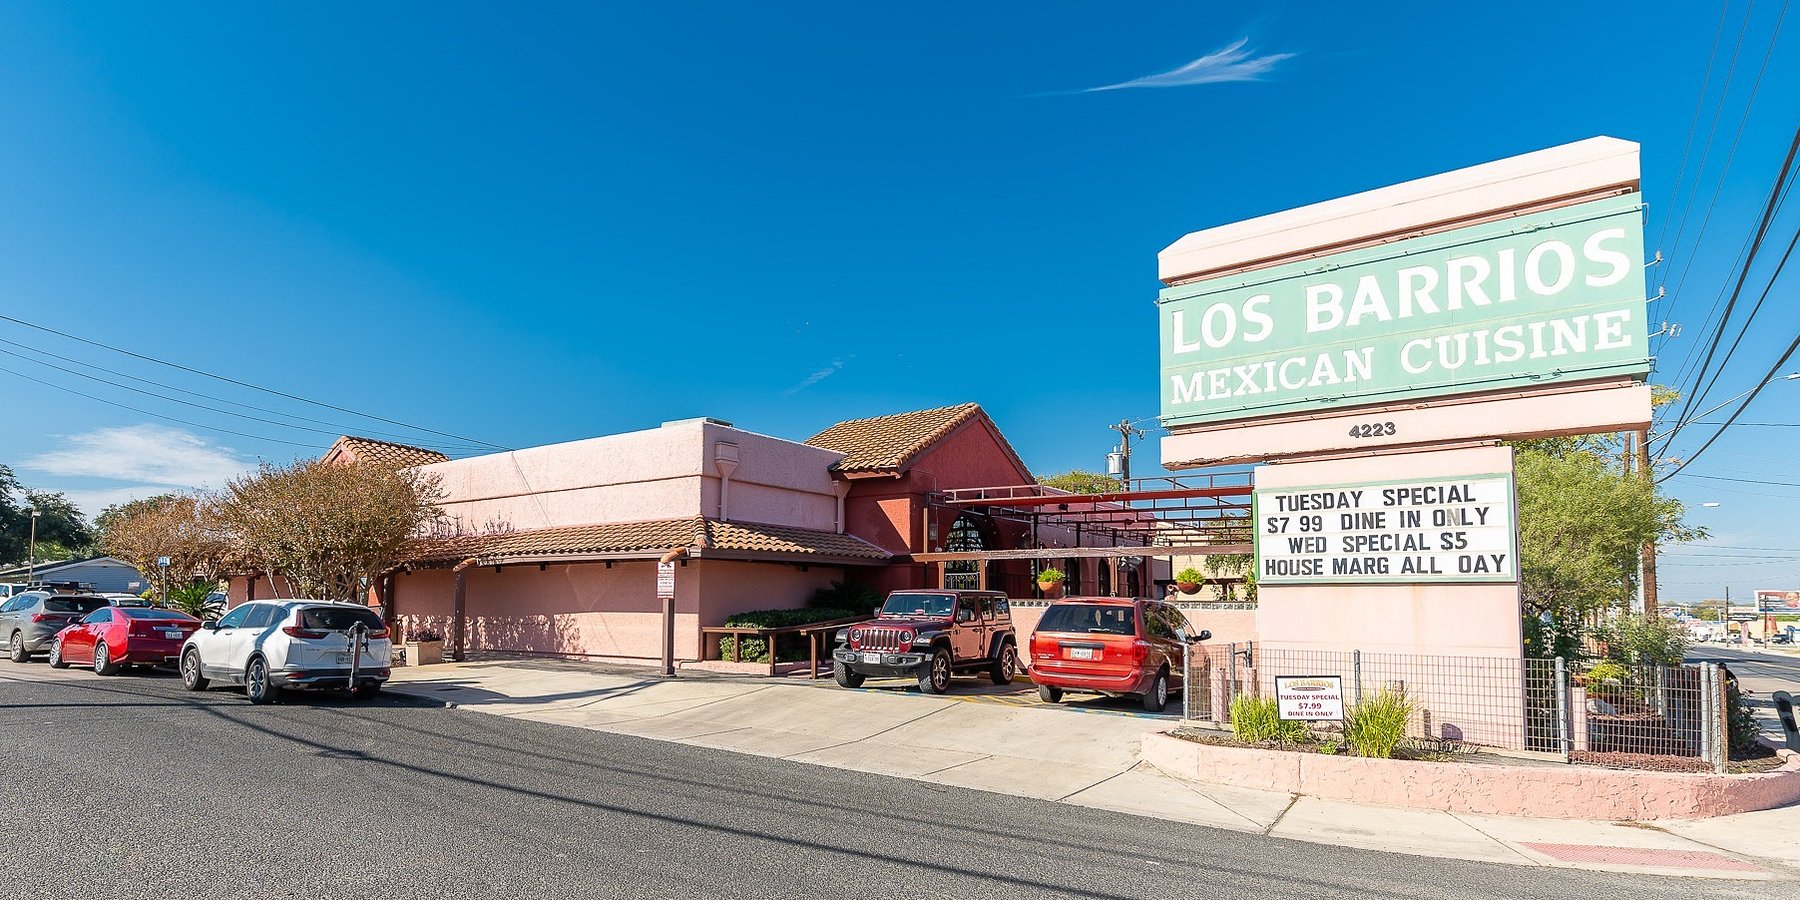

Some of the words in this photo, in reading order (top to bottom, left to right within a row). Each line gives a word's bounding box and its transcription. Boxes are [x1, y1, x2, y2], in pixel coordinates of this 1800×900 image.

[1172, 294, 1274, 354] LOS
[1305, 227, 1632, 334] BARRIOS
[1171, 346, 1374, 404] MEXICAN
[1400, 308, 1633, 375] CUISINE
[1348, 420, 1397, 438] 4223
[1276, 490, 1363, 512] TUESDAY
[1383, 484, 1476, 507] SPECIAL
[1341, 511, 1386, 531] DINE
[1400, 510, 1421, 529] IN
[1433, 506, 1490, 527] ONLY
[1288, 536, 1327, 554] WED
[1342, 532, 1431, 553] SPECIAL
[1440, 531, 1468, 551] $5
[1265, 558, 1324, 576] HOUSE
[1332, 557, 1389, 575] MARG
[1401, 556, 1442, 574] ALL
[1284, 680, 1298, 688] LOS
[1300, 680, 1334, 688] BARRIOS
[1298, 702, 1322, 710] $7.99
